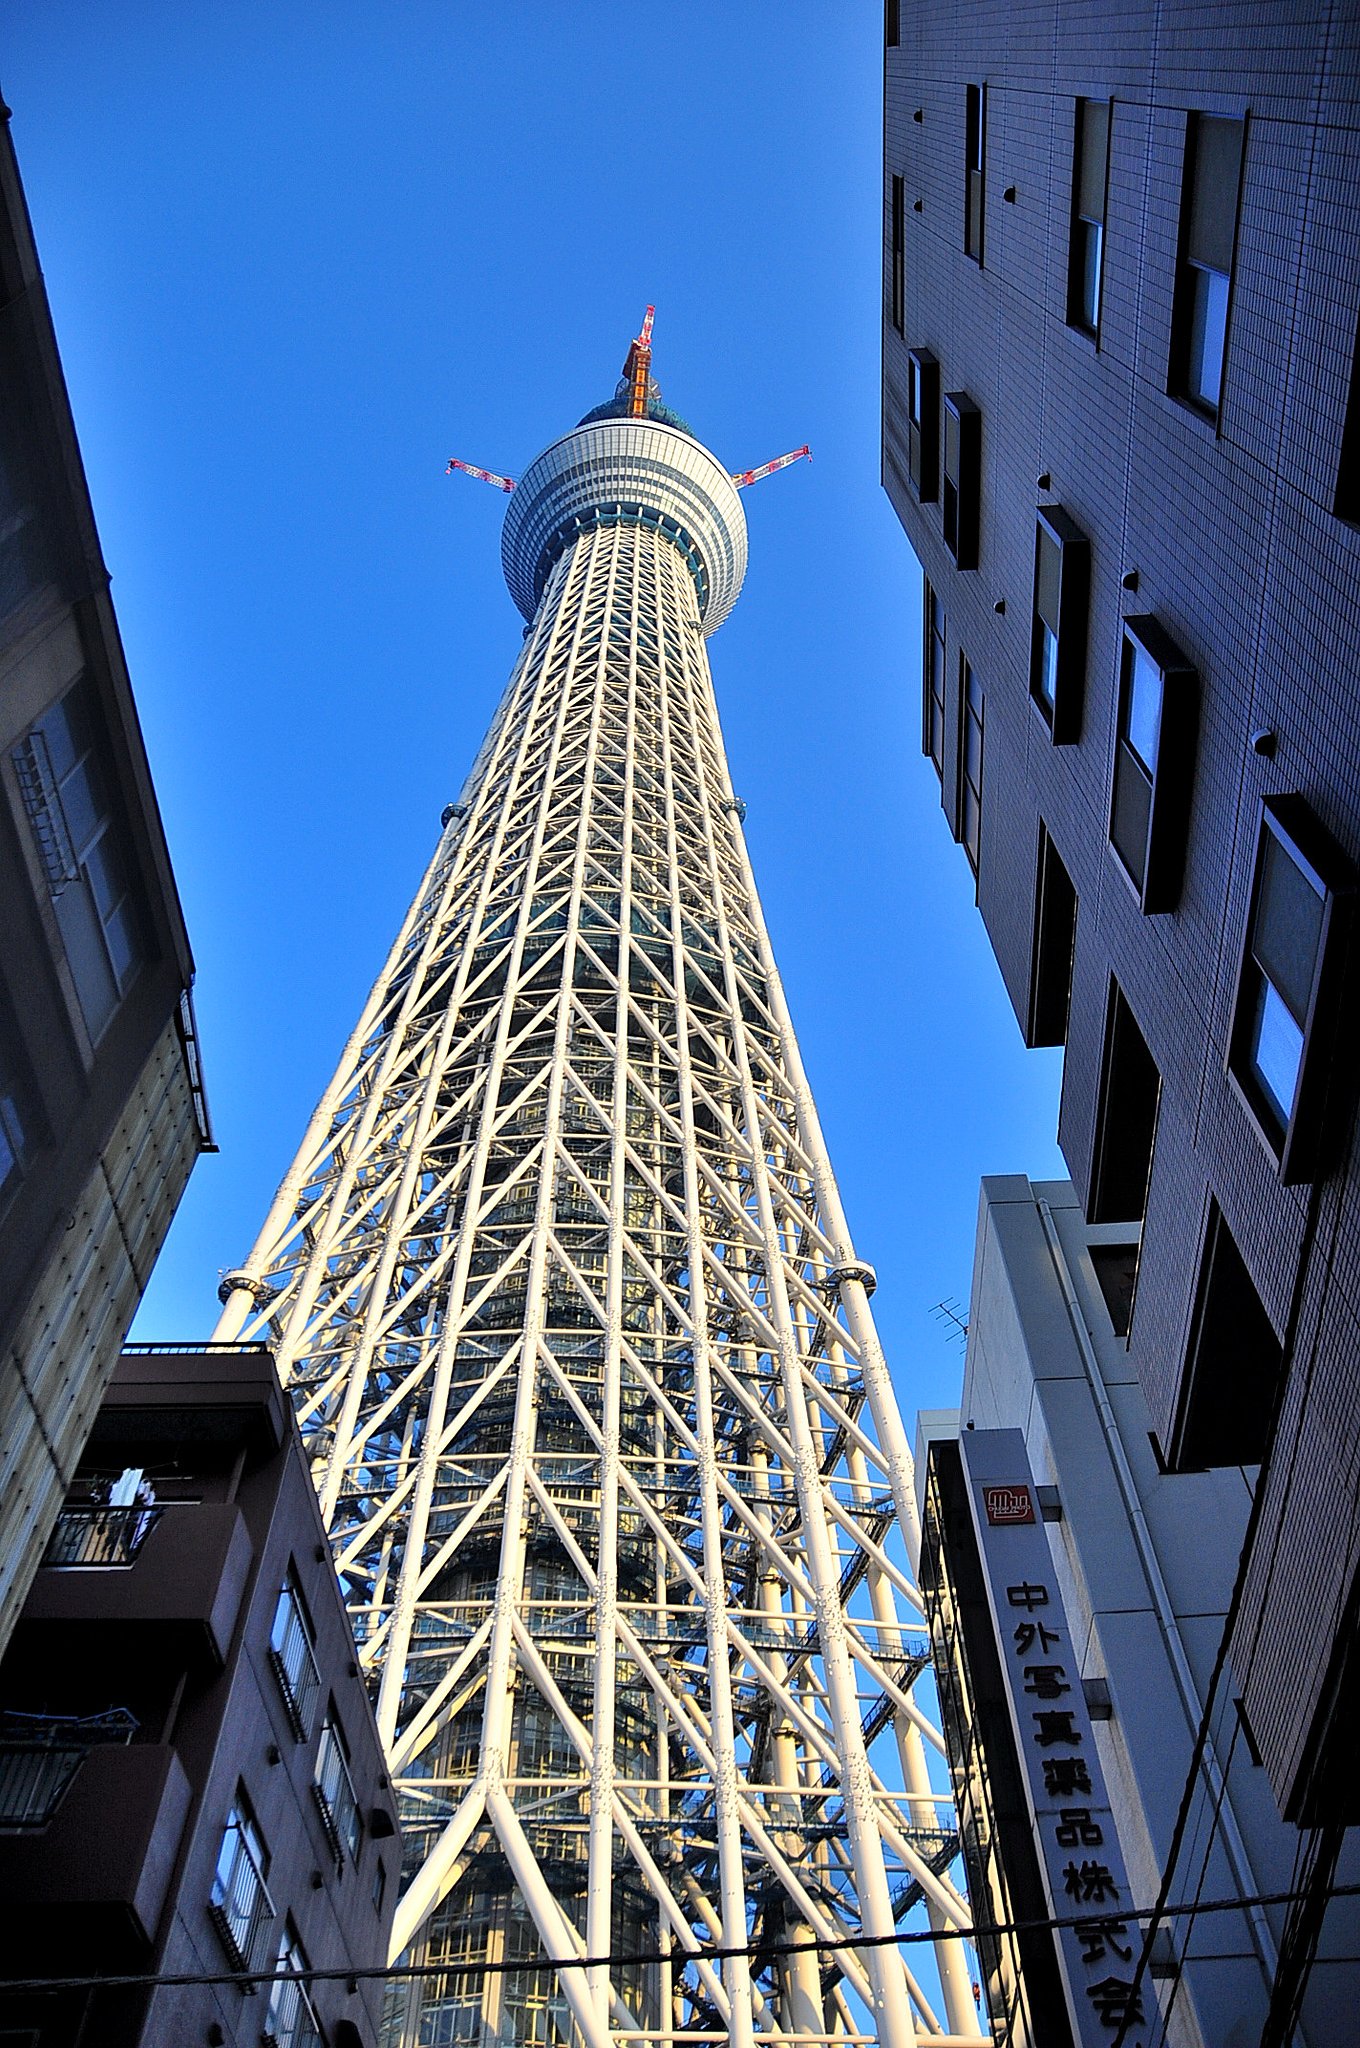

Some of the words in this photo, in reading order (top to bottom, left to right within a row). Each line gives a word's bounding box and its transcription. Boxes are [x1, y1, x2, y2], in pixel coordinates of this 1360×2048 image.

[1007, 1581, 1147, 2048] 中外写真薬品株式会
